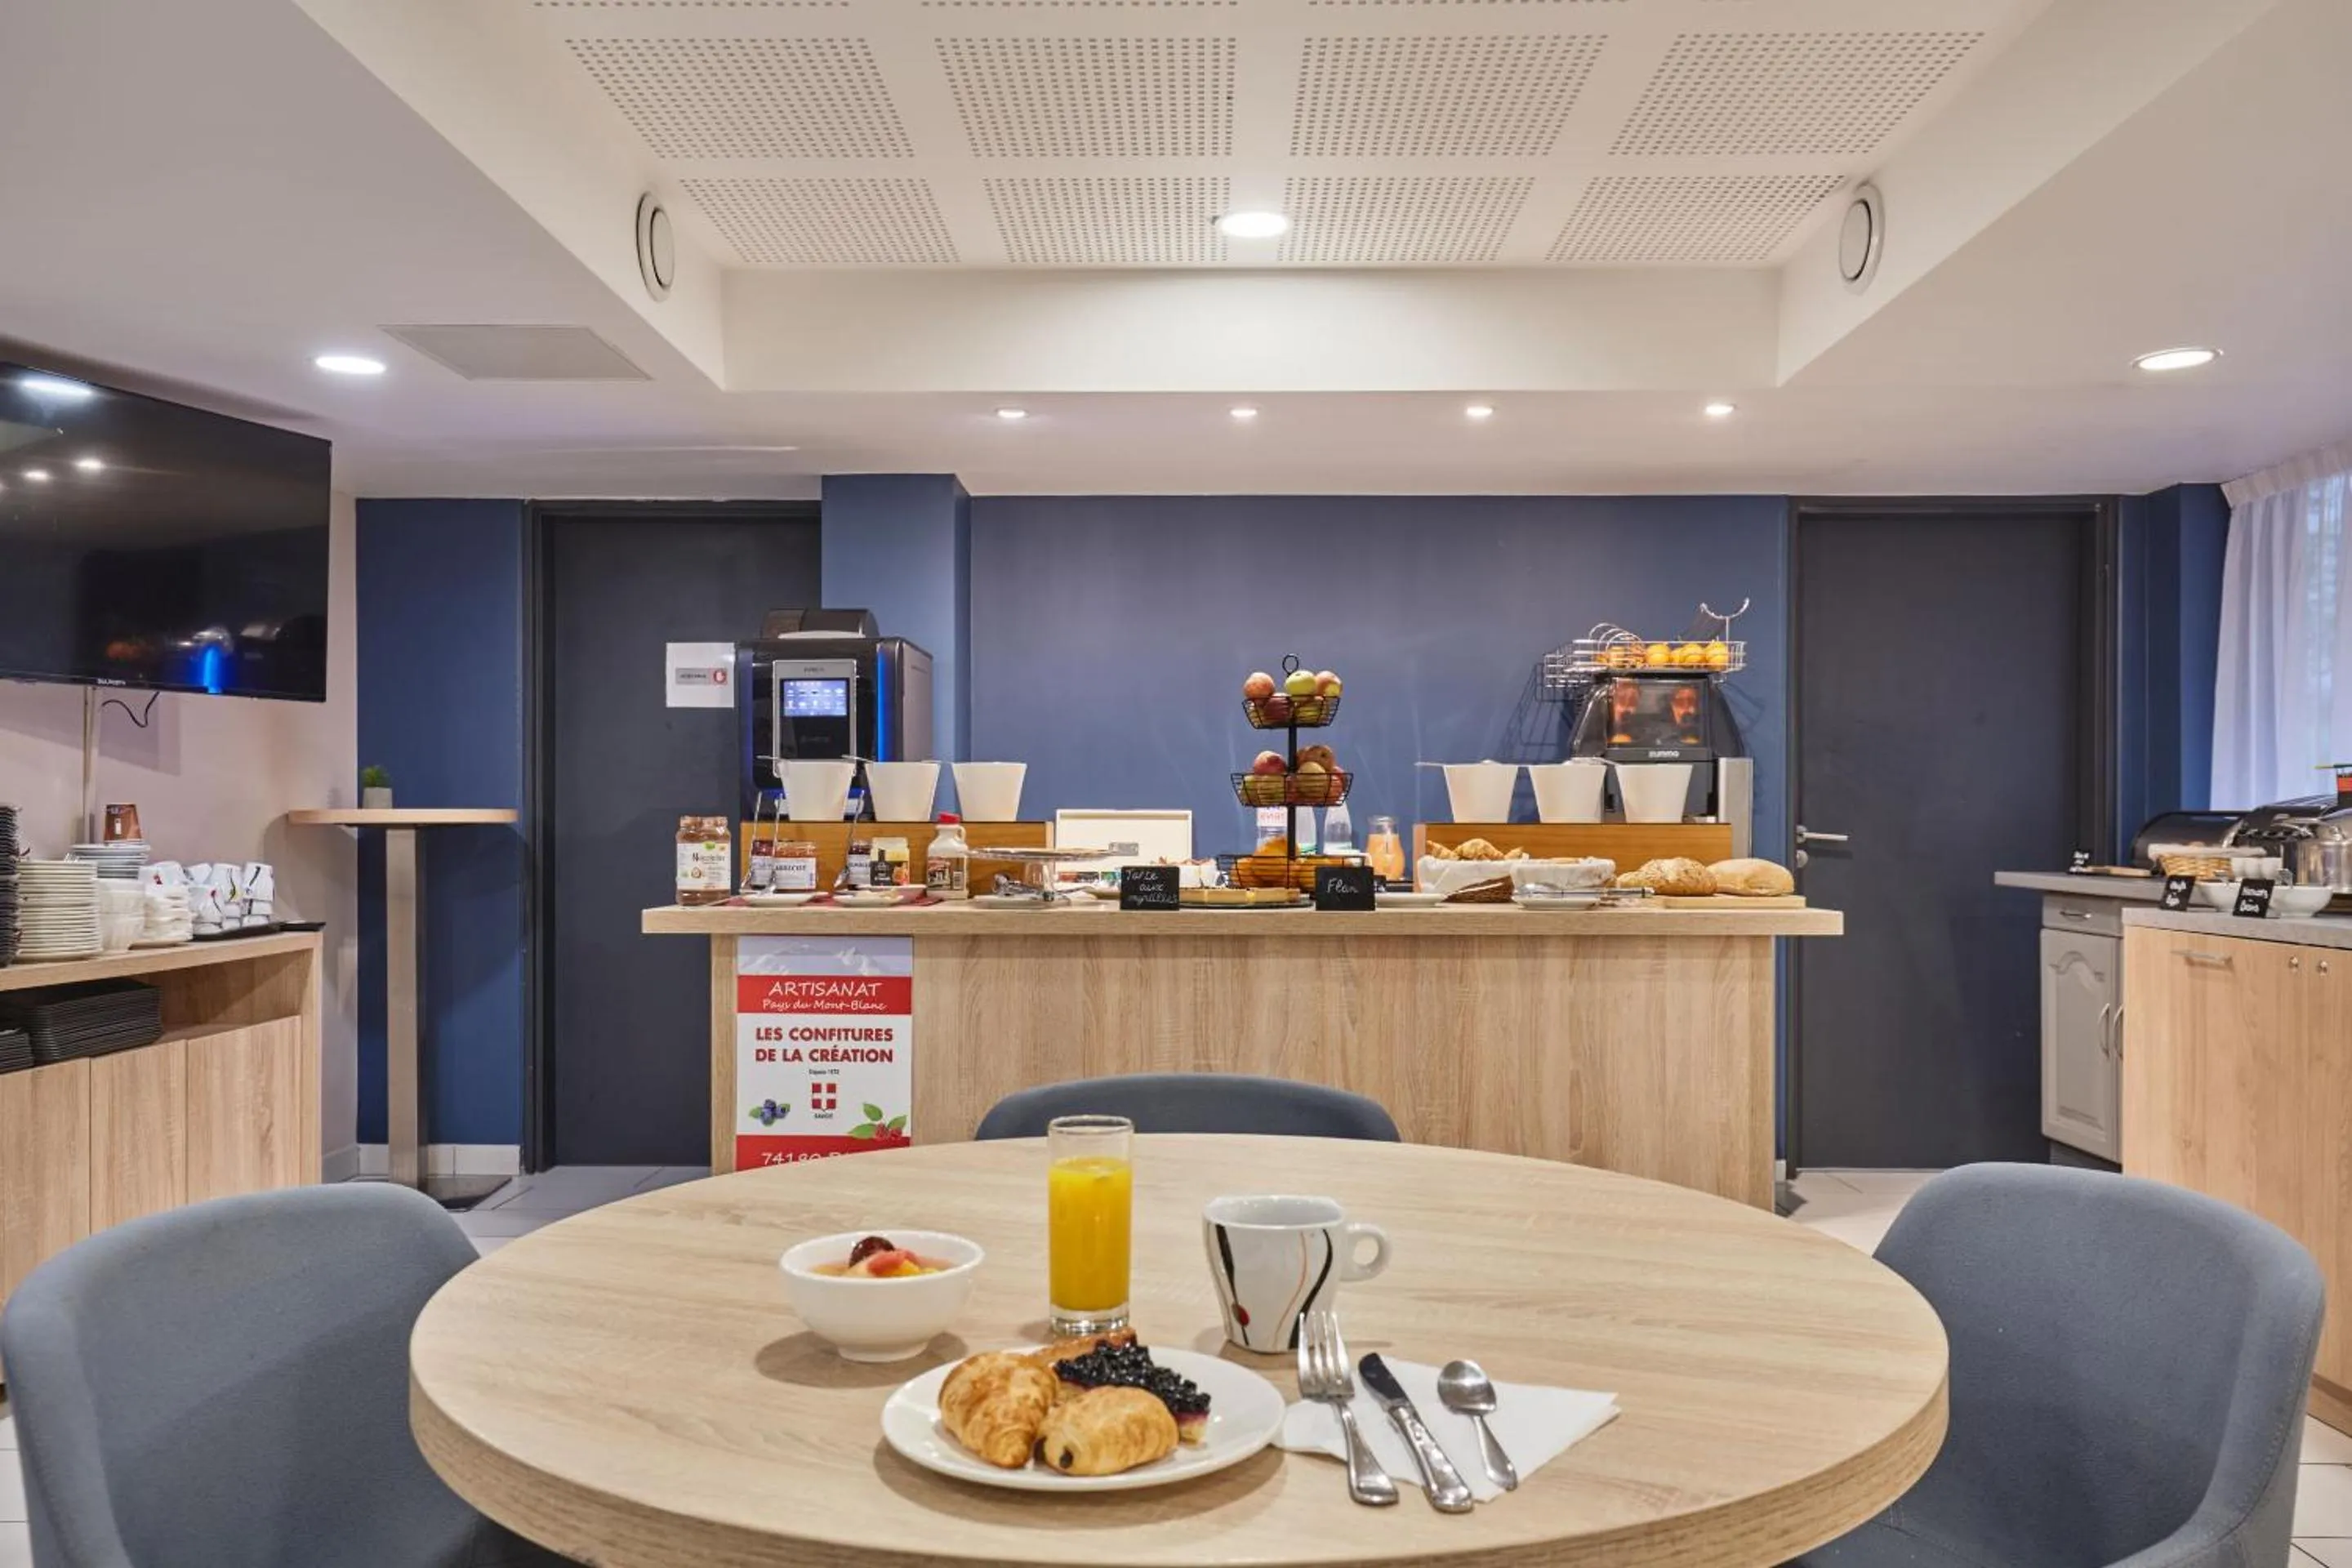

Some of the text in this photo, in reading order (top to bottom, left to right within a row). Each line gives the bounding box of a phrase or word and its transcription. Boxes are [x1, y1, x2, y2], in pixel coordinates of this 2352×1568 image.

[1326, 877, 1359, 893] Flan
[768, 981, 883, 997] ARTISANAT
[763, 998, 888, 1012] Pays du Mont-Blanc
[755, 1027, 893, 1042] LES CONFITURES
[755, 1045, 893, 1063] DE LA CRÉATION
